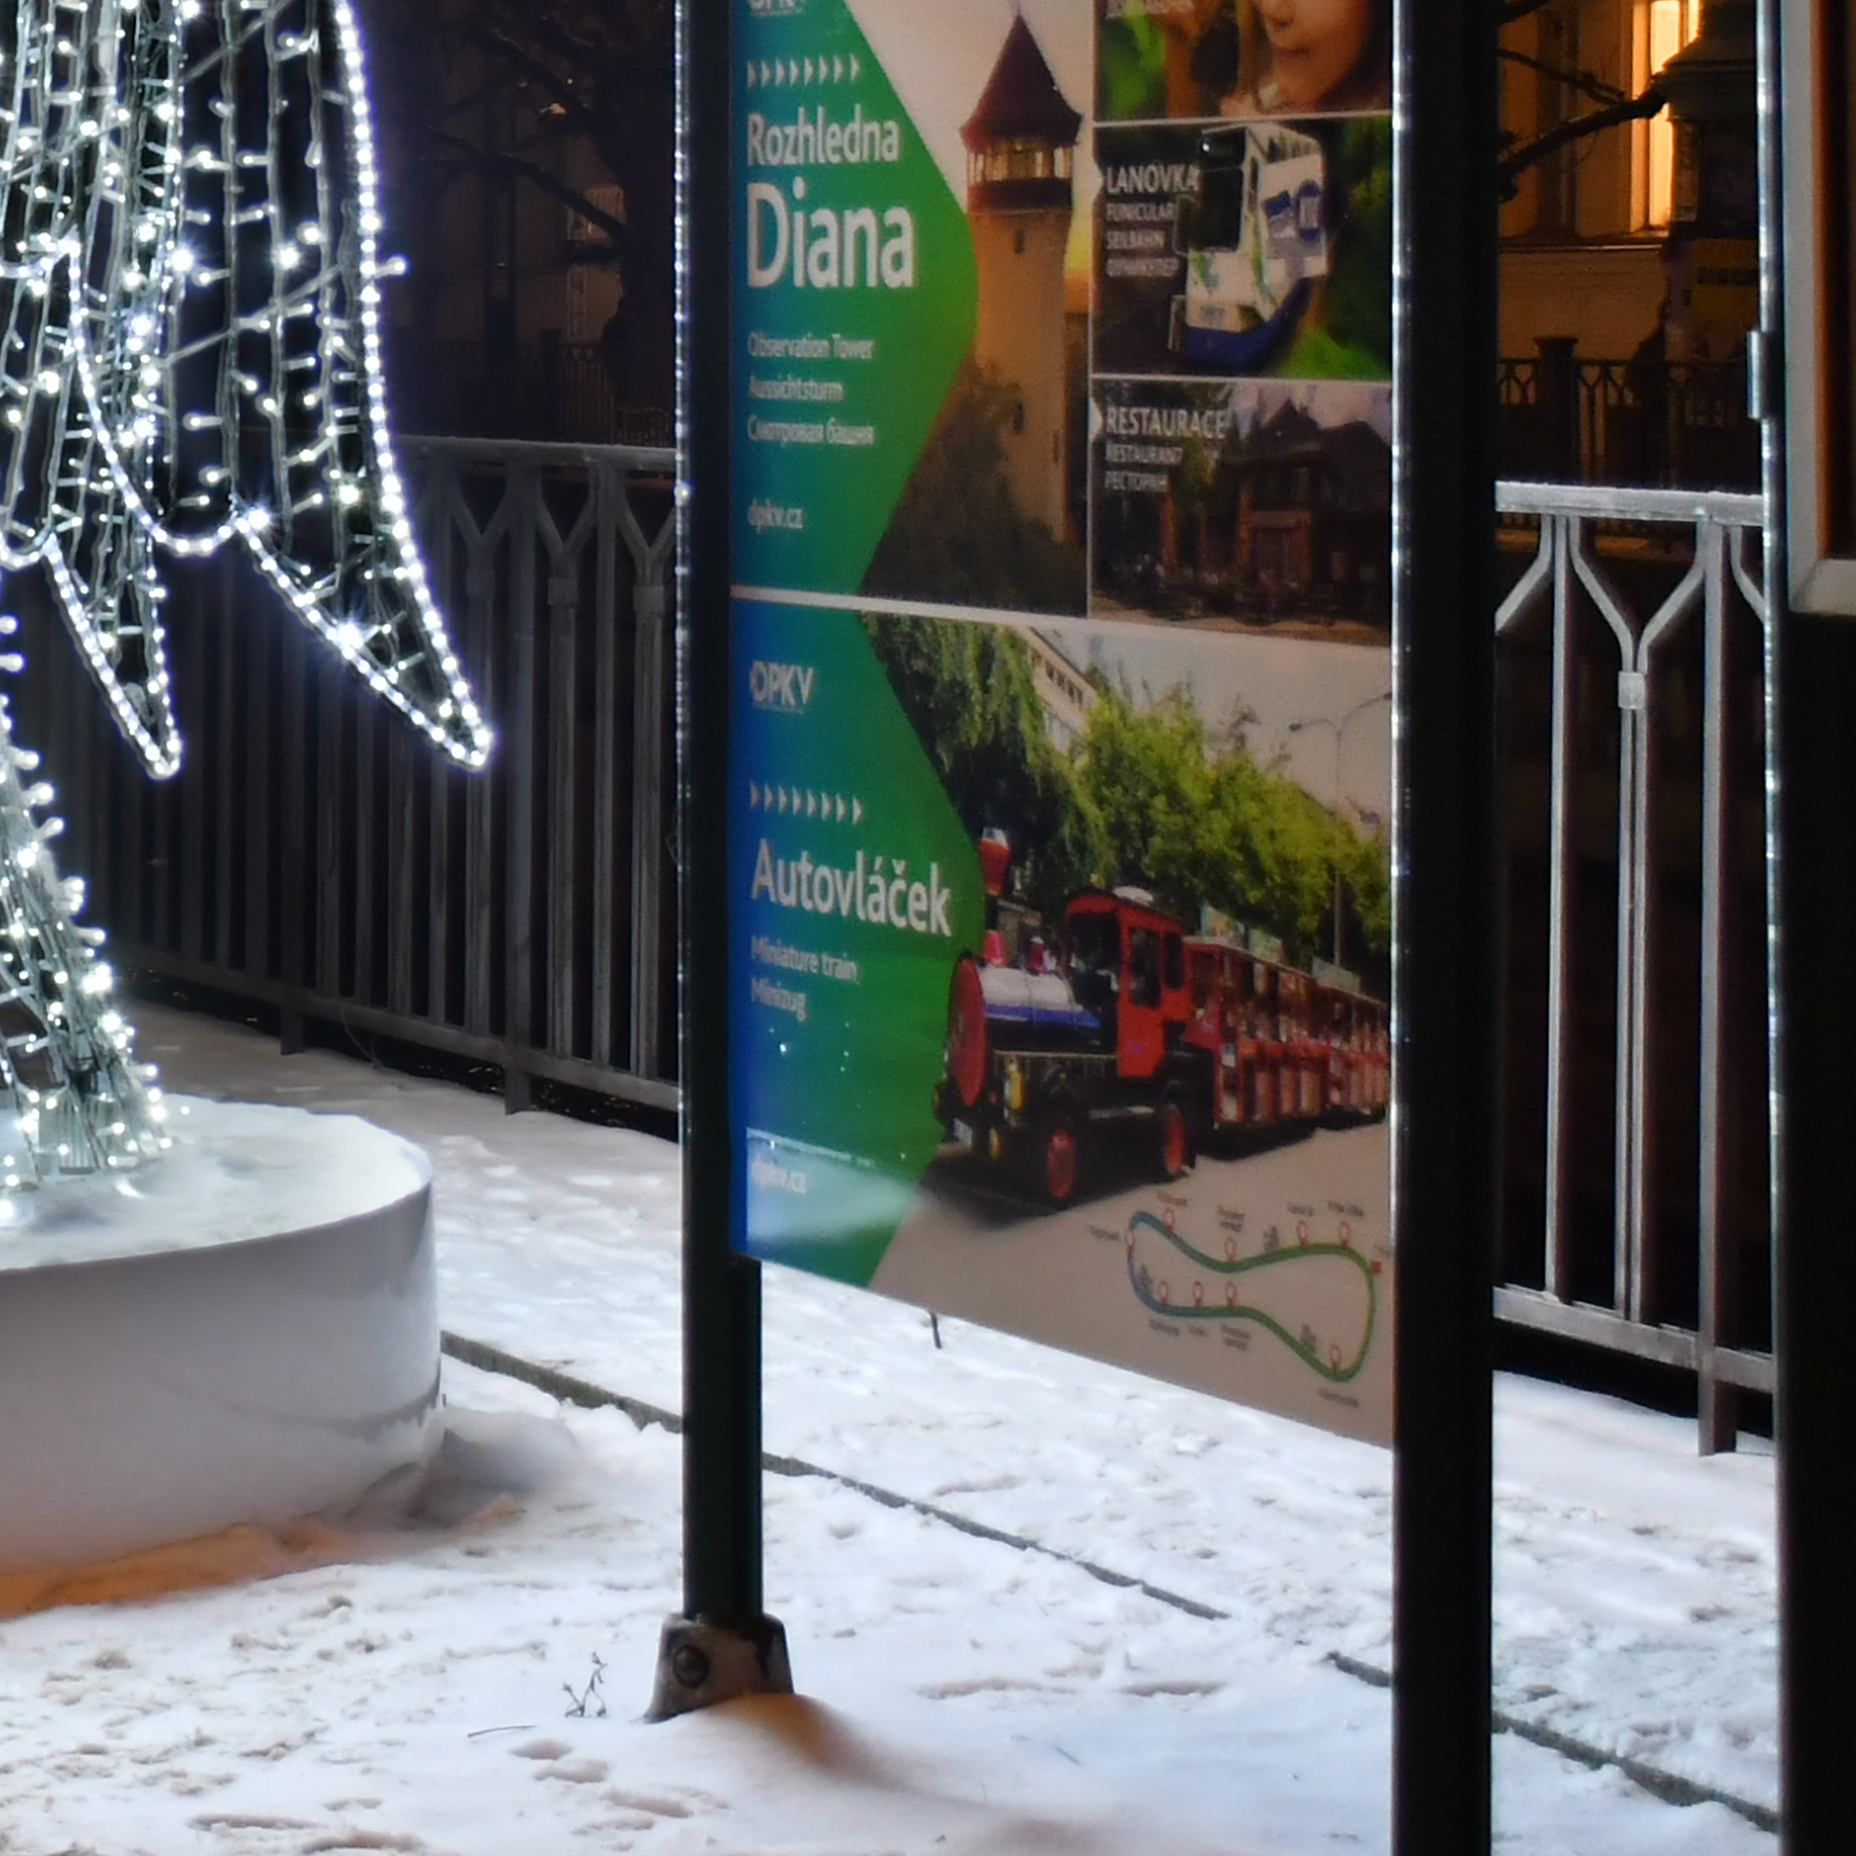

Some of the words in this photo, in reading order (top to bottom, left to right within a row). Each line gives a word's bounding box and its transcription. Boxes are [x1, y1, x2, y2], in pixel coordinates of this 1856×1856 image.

[747, 103, 901, 167] Rozhledna
[1106, 163, 1201, 195] LANOVKA
[746, 175, 916, 291] Diana
[1105, 405, 1227, 440] RESTAURACE
[750, 838, 953, 938] Autovláček
[750, 934, 819, 975] Miniature
[820, 951, 859, 982] train
